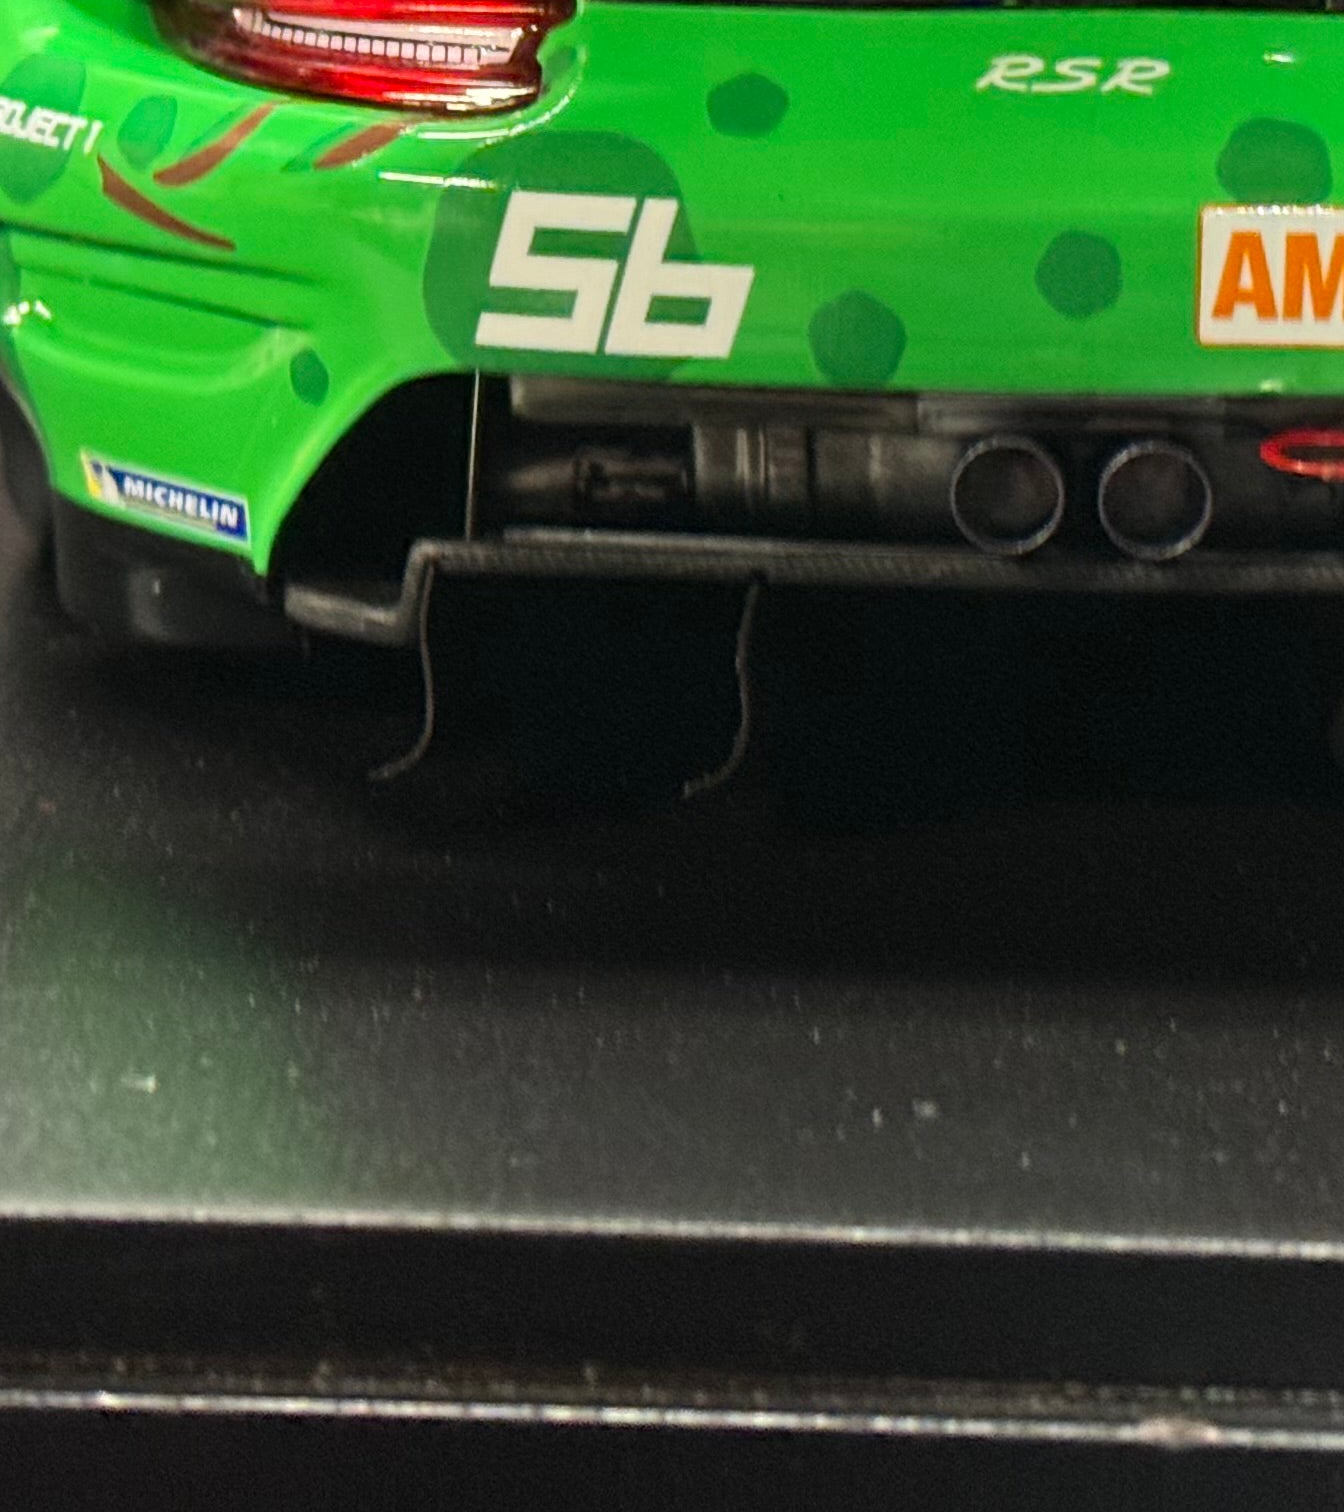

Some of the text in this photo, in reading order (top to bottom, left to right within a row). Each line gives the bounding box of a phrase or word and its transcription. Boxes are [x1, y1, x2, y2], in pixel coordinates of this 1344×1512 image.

[976, 54, 1170, 94] RSR
[475, 190, 755, 359] 56
[123, 475, 239, 529] MICHELIN
